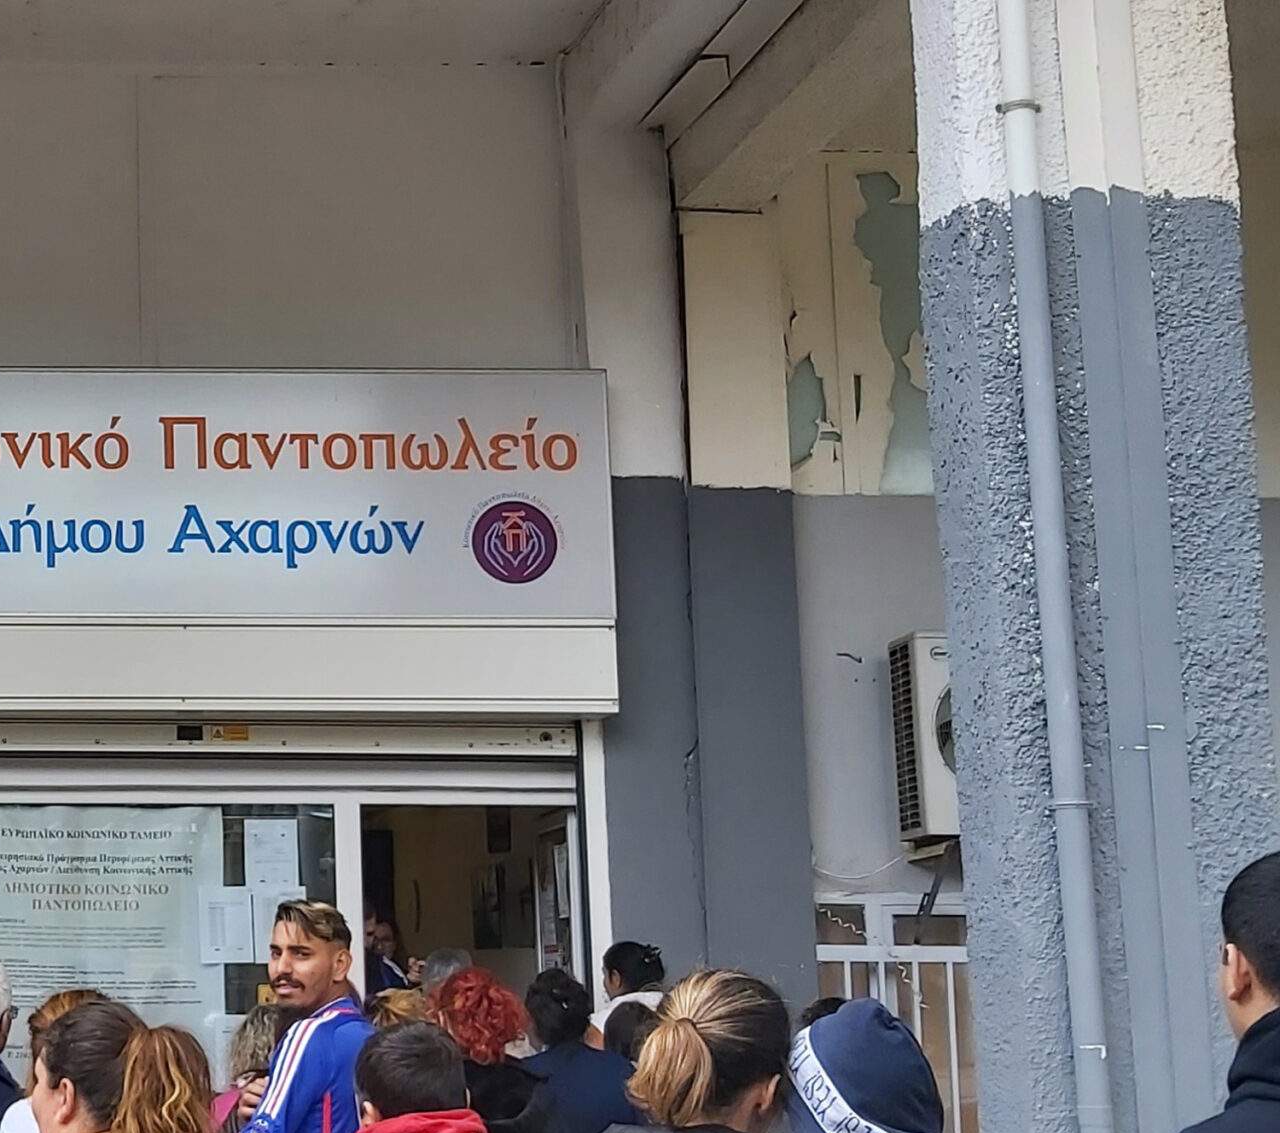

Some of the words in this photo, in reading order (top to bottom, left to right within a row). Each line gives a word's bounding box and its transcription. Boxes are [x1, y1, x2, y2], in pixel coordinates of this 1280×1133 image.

[158, 414, 578, 473] Παντοπωλείο
[168, 503, 425, 570] Αχαρνών
[3, 882, 81, 895] ΔΗΜΟΤΙΚΟ
[84, 883, 169, 896] ΚΟΙΝΩΝΙΚΟ
[32, 899, 140, 912] ΠΑΝΤΟΠΩΛΕΙΟ
